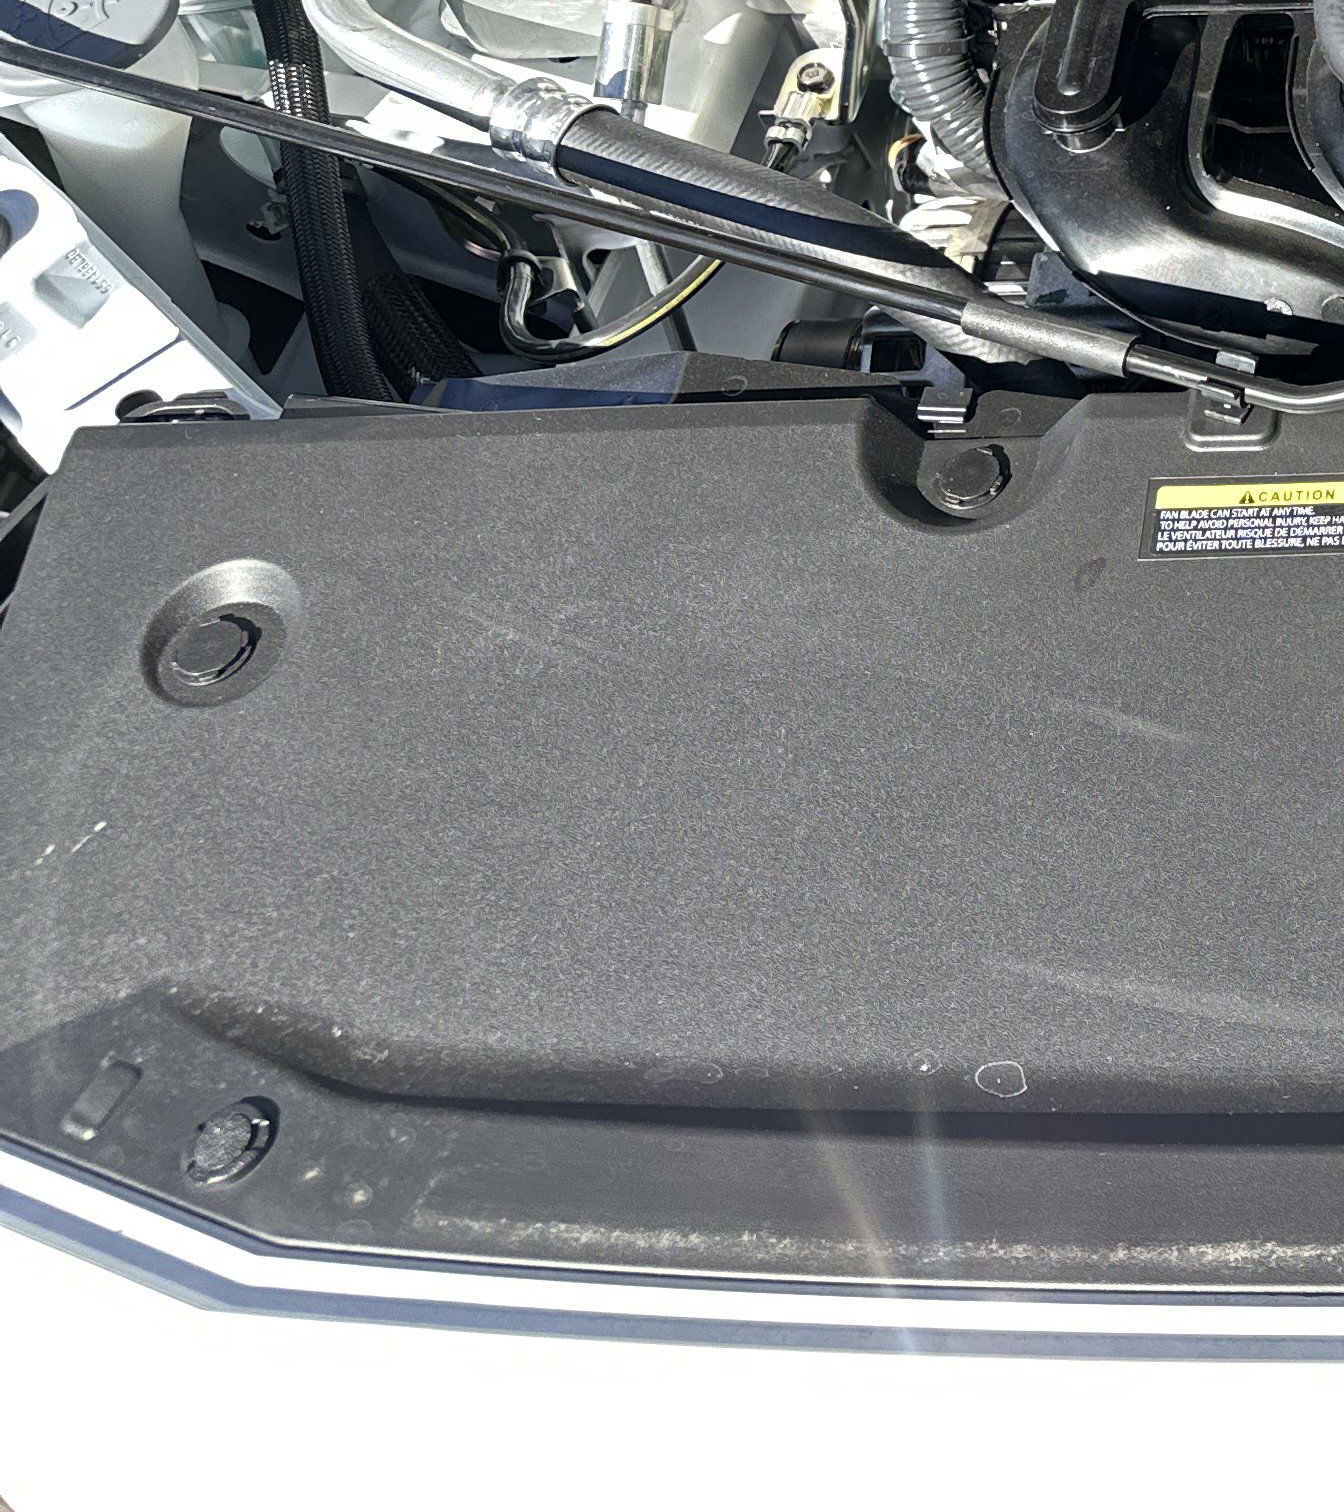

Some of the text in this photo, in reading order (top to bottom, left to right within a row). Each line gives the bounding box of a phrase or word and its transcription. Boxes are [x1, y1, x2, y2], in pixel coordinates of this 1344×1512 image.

[1258, 489, 1336, 502] CAUTION
[1160, 510, 1179, 520] FAN
[1180, 509, 1210, 519] BLADE
[1211, 508, 1231, 518] CAN
[1232, 508, 1258, 518] START
[1259, 508, 1271, 517] AT
[1272, 507, 1291, 516] ANY
[1160, 520, 1173, 530] TO
[1174, 519, 1197, 529] HELP
[1198, 518, 1226, 528] AVOID
[1228, 517, 1274, 528] PERSONAL
[1309, 515, 1331, 525] KEEP
[1158, 531, 1170, 541] LE
[1171, 529, 1236, 540] VENTILATEUR
[1237, 527, 1273, 539] RISQUE
[1274, 527, 1288, 537] DE
[1156, 541, 1185, 552] POUR
[1221, 539, 1253, 549] TOUTE
[1306, 536, 1321, 546] NE
[1321, 535, 1340, 545] PAS
